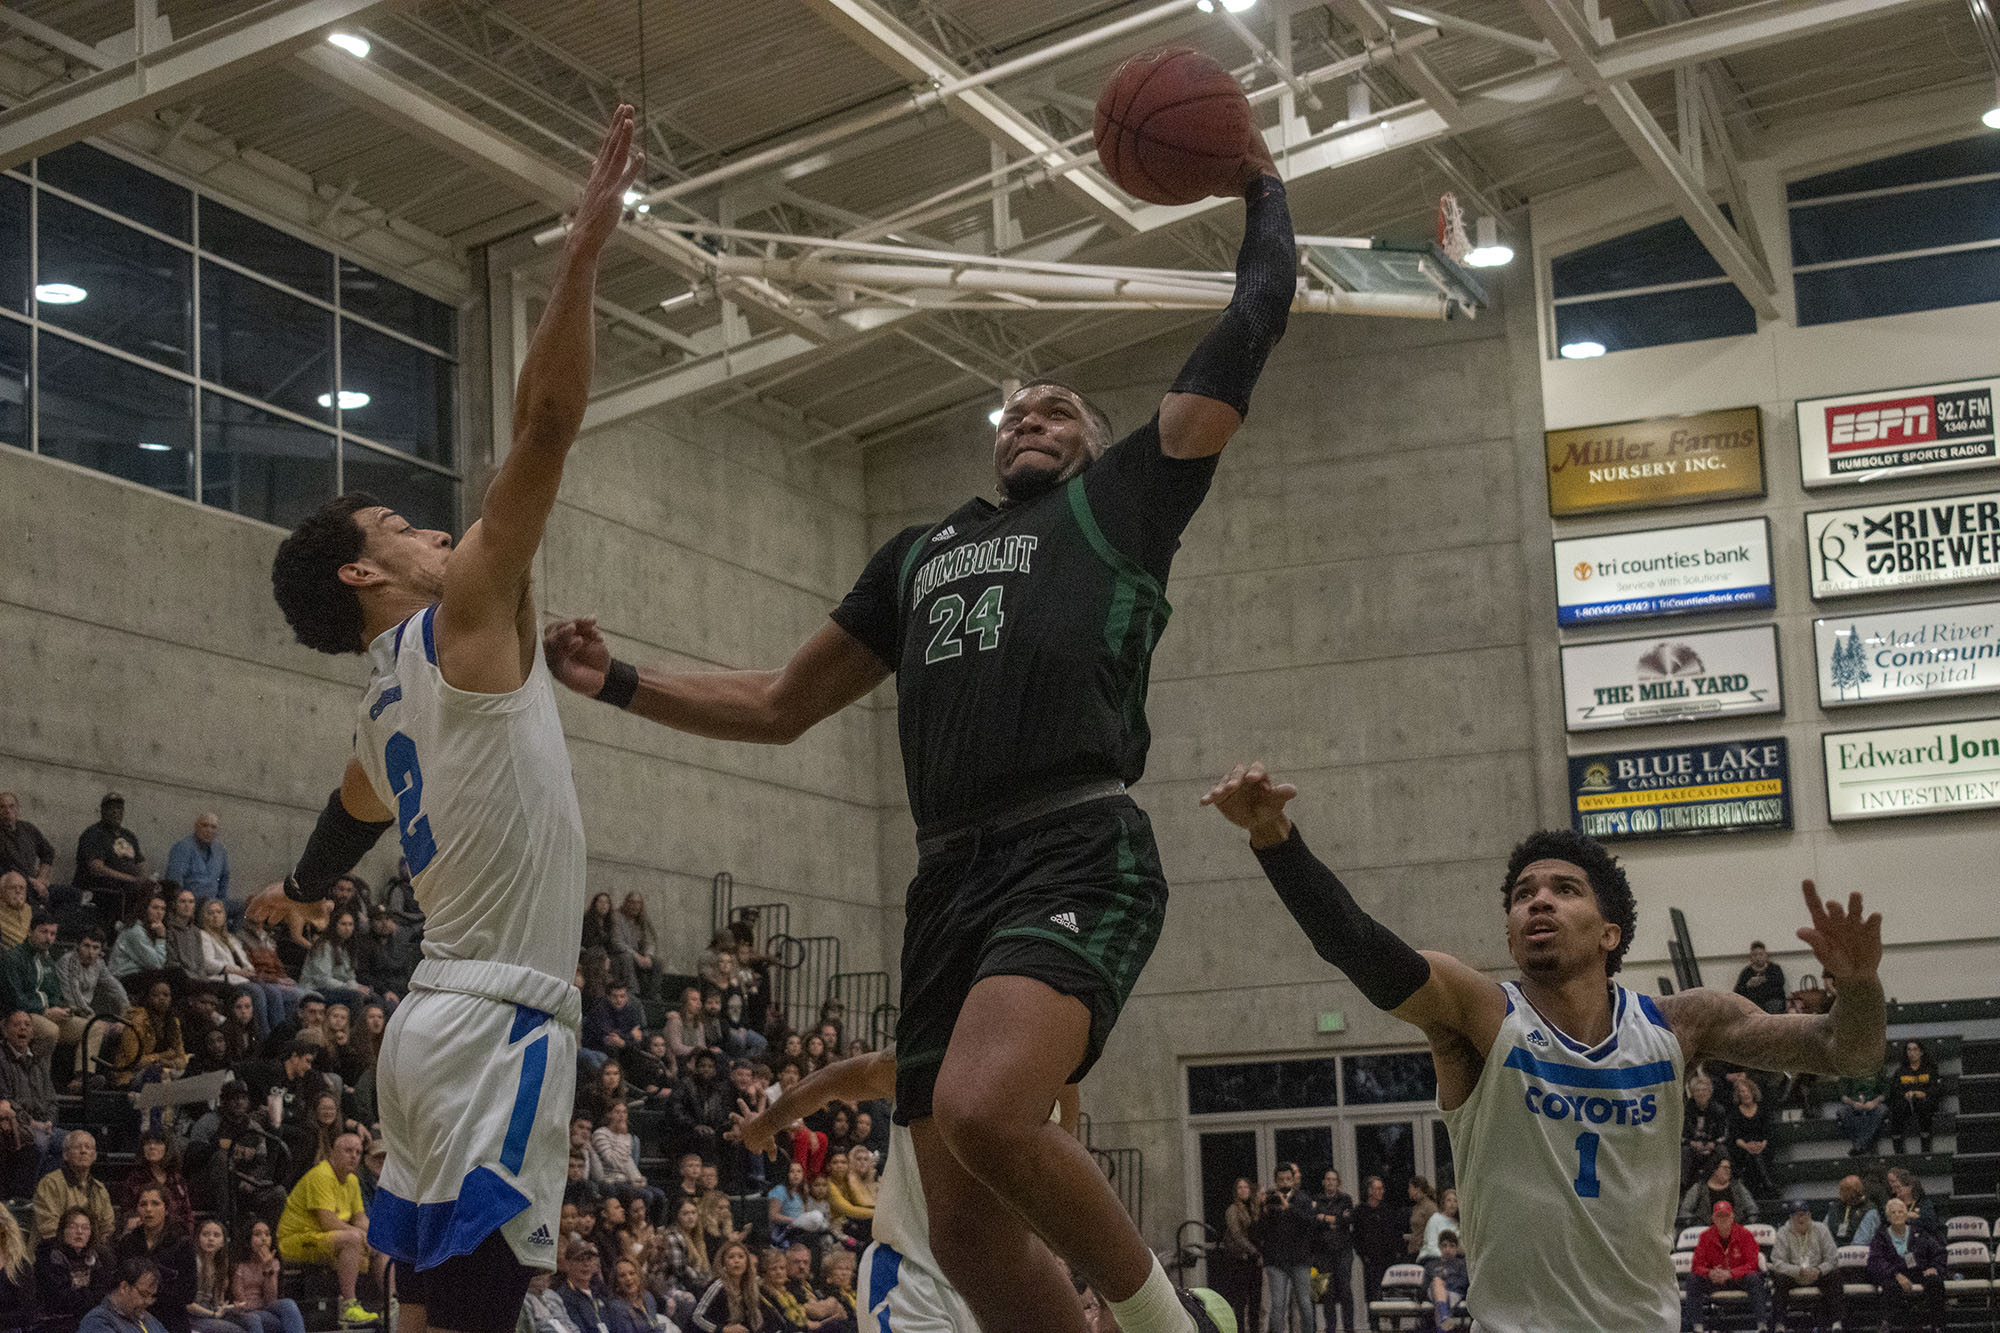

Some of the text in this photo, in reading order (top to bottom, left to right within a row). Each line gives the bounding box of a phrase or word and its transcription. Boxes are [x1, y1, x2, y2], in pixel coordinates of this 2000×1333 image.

[1937, 397, 1990, 421] 92.7 FM
[1831, 405, 1929, 445] ESPN
[1944, 418, 1986, 433] 1340 AM
[1552, 427, 1755, 473] Miller Farms
[1837, 443, 1987, 471] HUMBOLDT SPORTS RADIO
[1589, 455, 1726, 483] NURSERY INC.
[913, 535, 1037, 611] HUMBOLDT
[1597, 546, 1750, 577] tri counties bank
[1617, 579, 1656, 592] Service
[1658, 576, 1681, 589] With
[926, 585, 1004, 665] 24
[1872, 622, 1993, 648] Mad River
[1594, 674, 1748, 706] THE MILL YARD
[1882, 663, 1976, 689] Hospital
[1618, 746, 1779, 779] BLUE LAKE
[1839, 735, 1943, 770] Edward
[1628, 768, 1769, 790] CASINO HOTEL
[385, 731, 438, 879] 2
[1860, 781, 2000, 809] INVESTMEN
[1631, 809, 1658, 832] GO
[1050, 915, 1080, 933] adidas
[1525, 1086, 1657, 1126] COYOTES
[1574, 1131, 1600, 1198] 1
[1948, 1222, 1984, 1230] SHOOT
[1948, 1247, 1984, 1256] SHOOT
